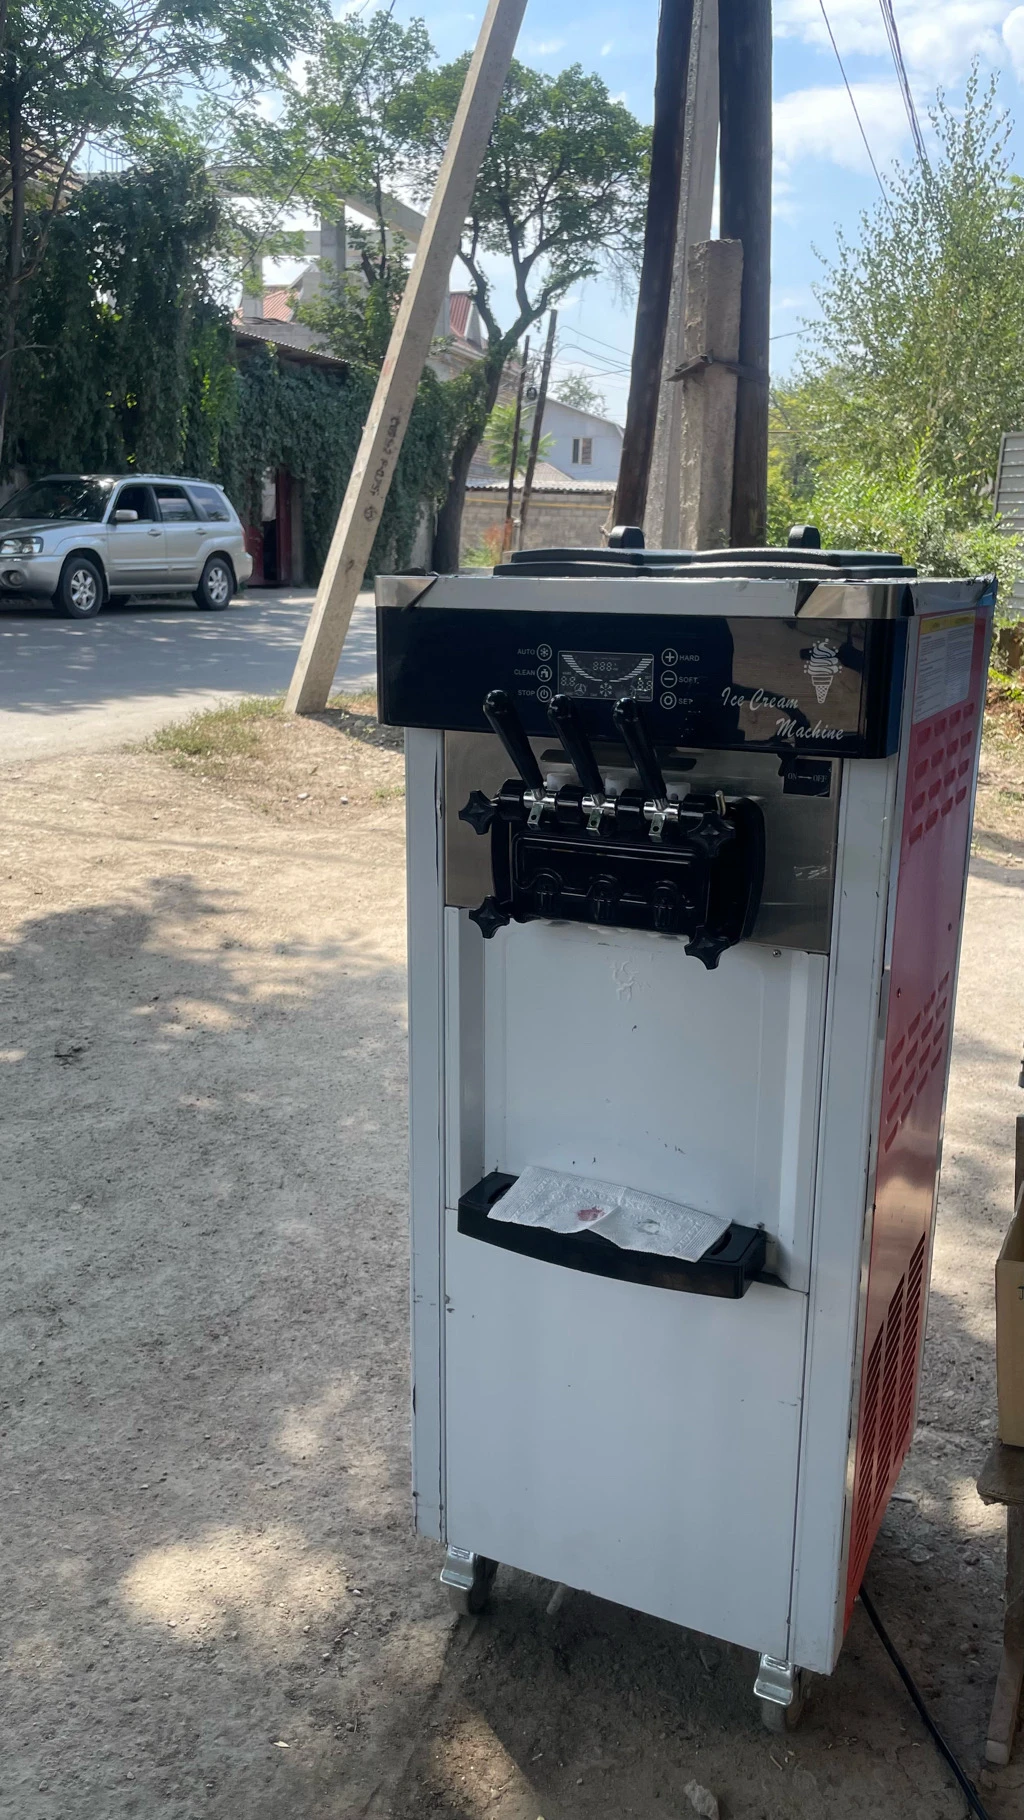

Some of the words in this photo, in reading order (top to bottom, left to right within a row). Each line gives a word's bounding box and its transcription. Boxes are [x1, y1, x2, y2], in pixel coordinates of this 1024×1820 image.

[517, 648, 536, 656] AUTO
[679, 654, 700, 662] HARD
[513, 668, 536, 676] CLEAN
[517, 689, 536, 697] STOP
[721, 686, 744, 707] Ice
[749, 687, 799, 711] Cream
[775, 717, 844, 741] Machine
[787, 772, 798, 780] ON
